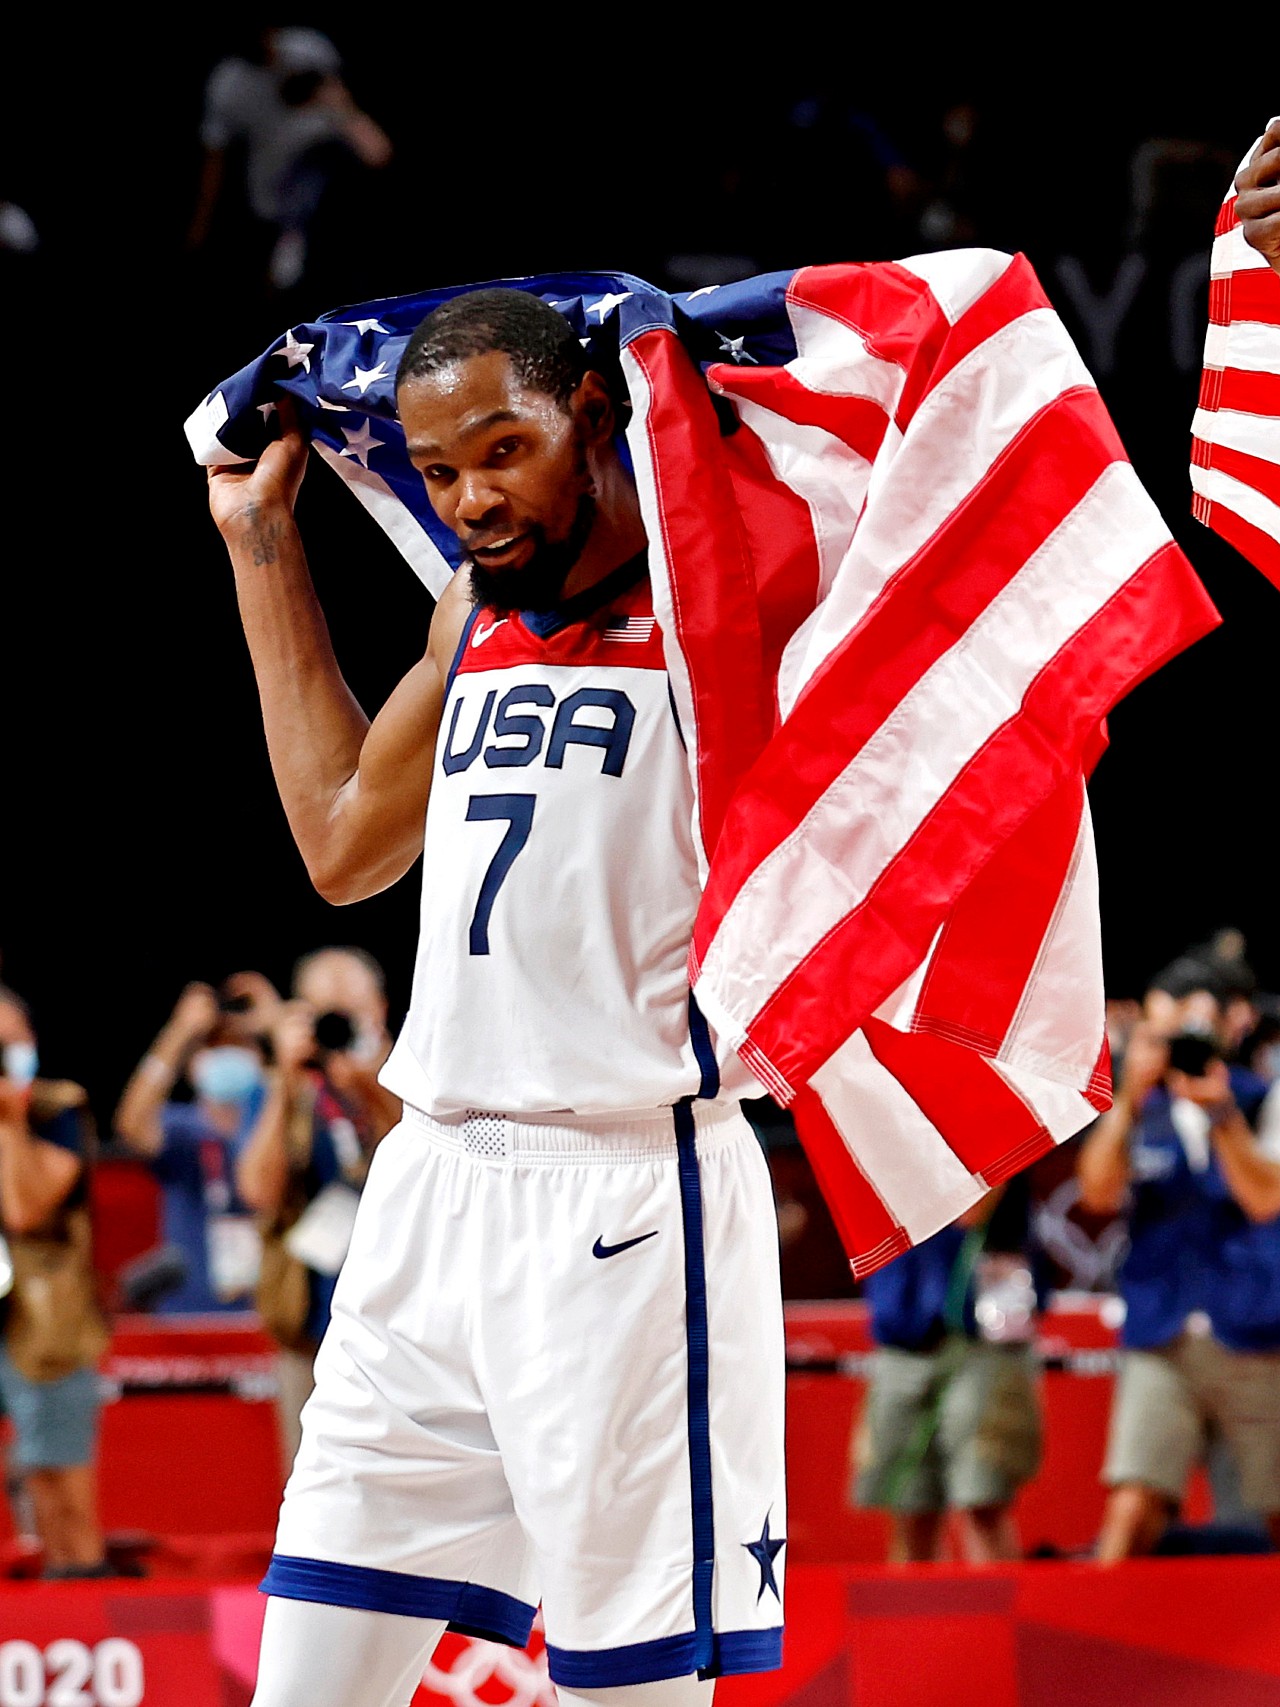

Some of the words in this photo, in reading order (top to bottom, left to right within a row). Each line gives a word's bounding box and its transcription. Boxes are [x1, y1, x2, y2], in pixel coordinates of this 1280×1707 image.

[442, 684, 636, 778] USA
[464, 792, 538, 955] 7
[0, 1636, 145, 1707] 020
